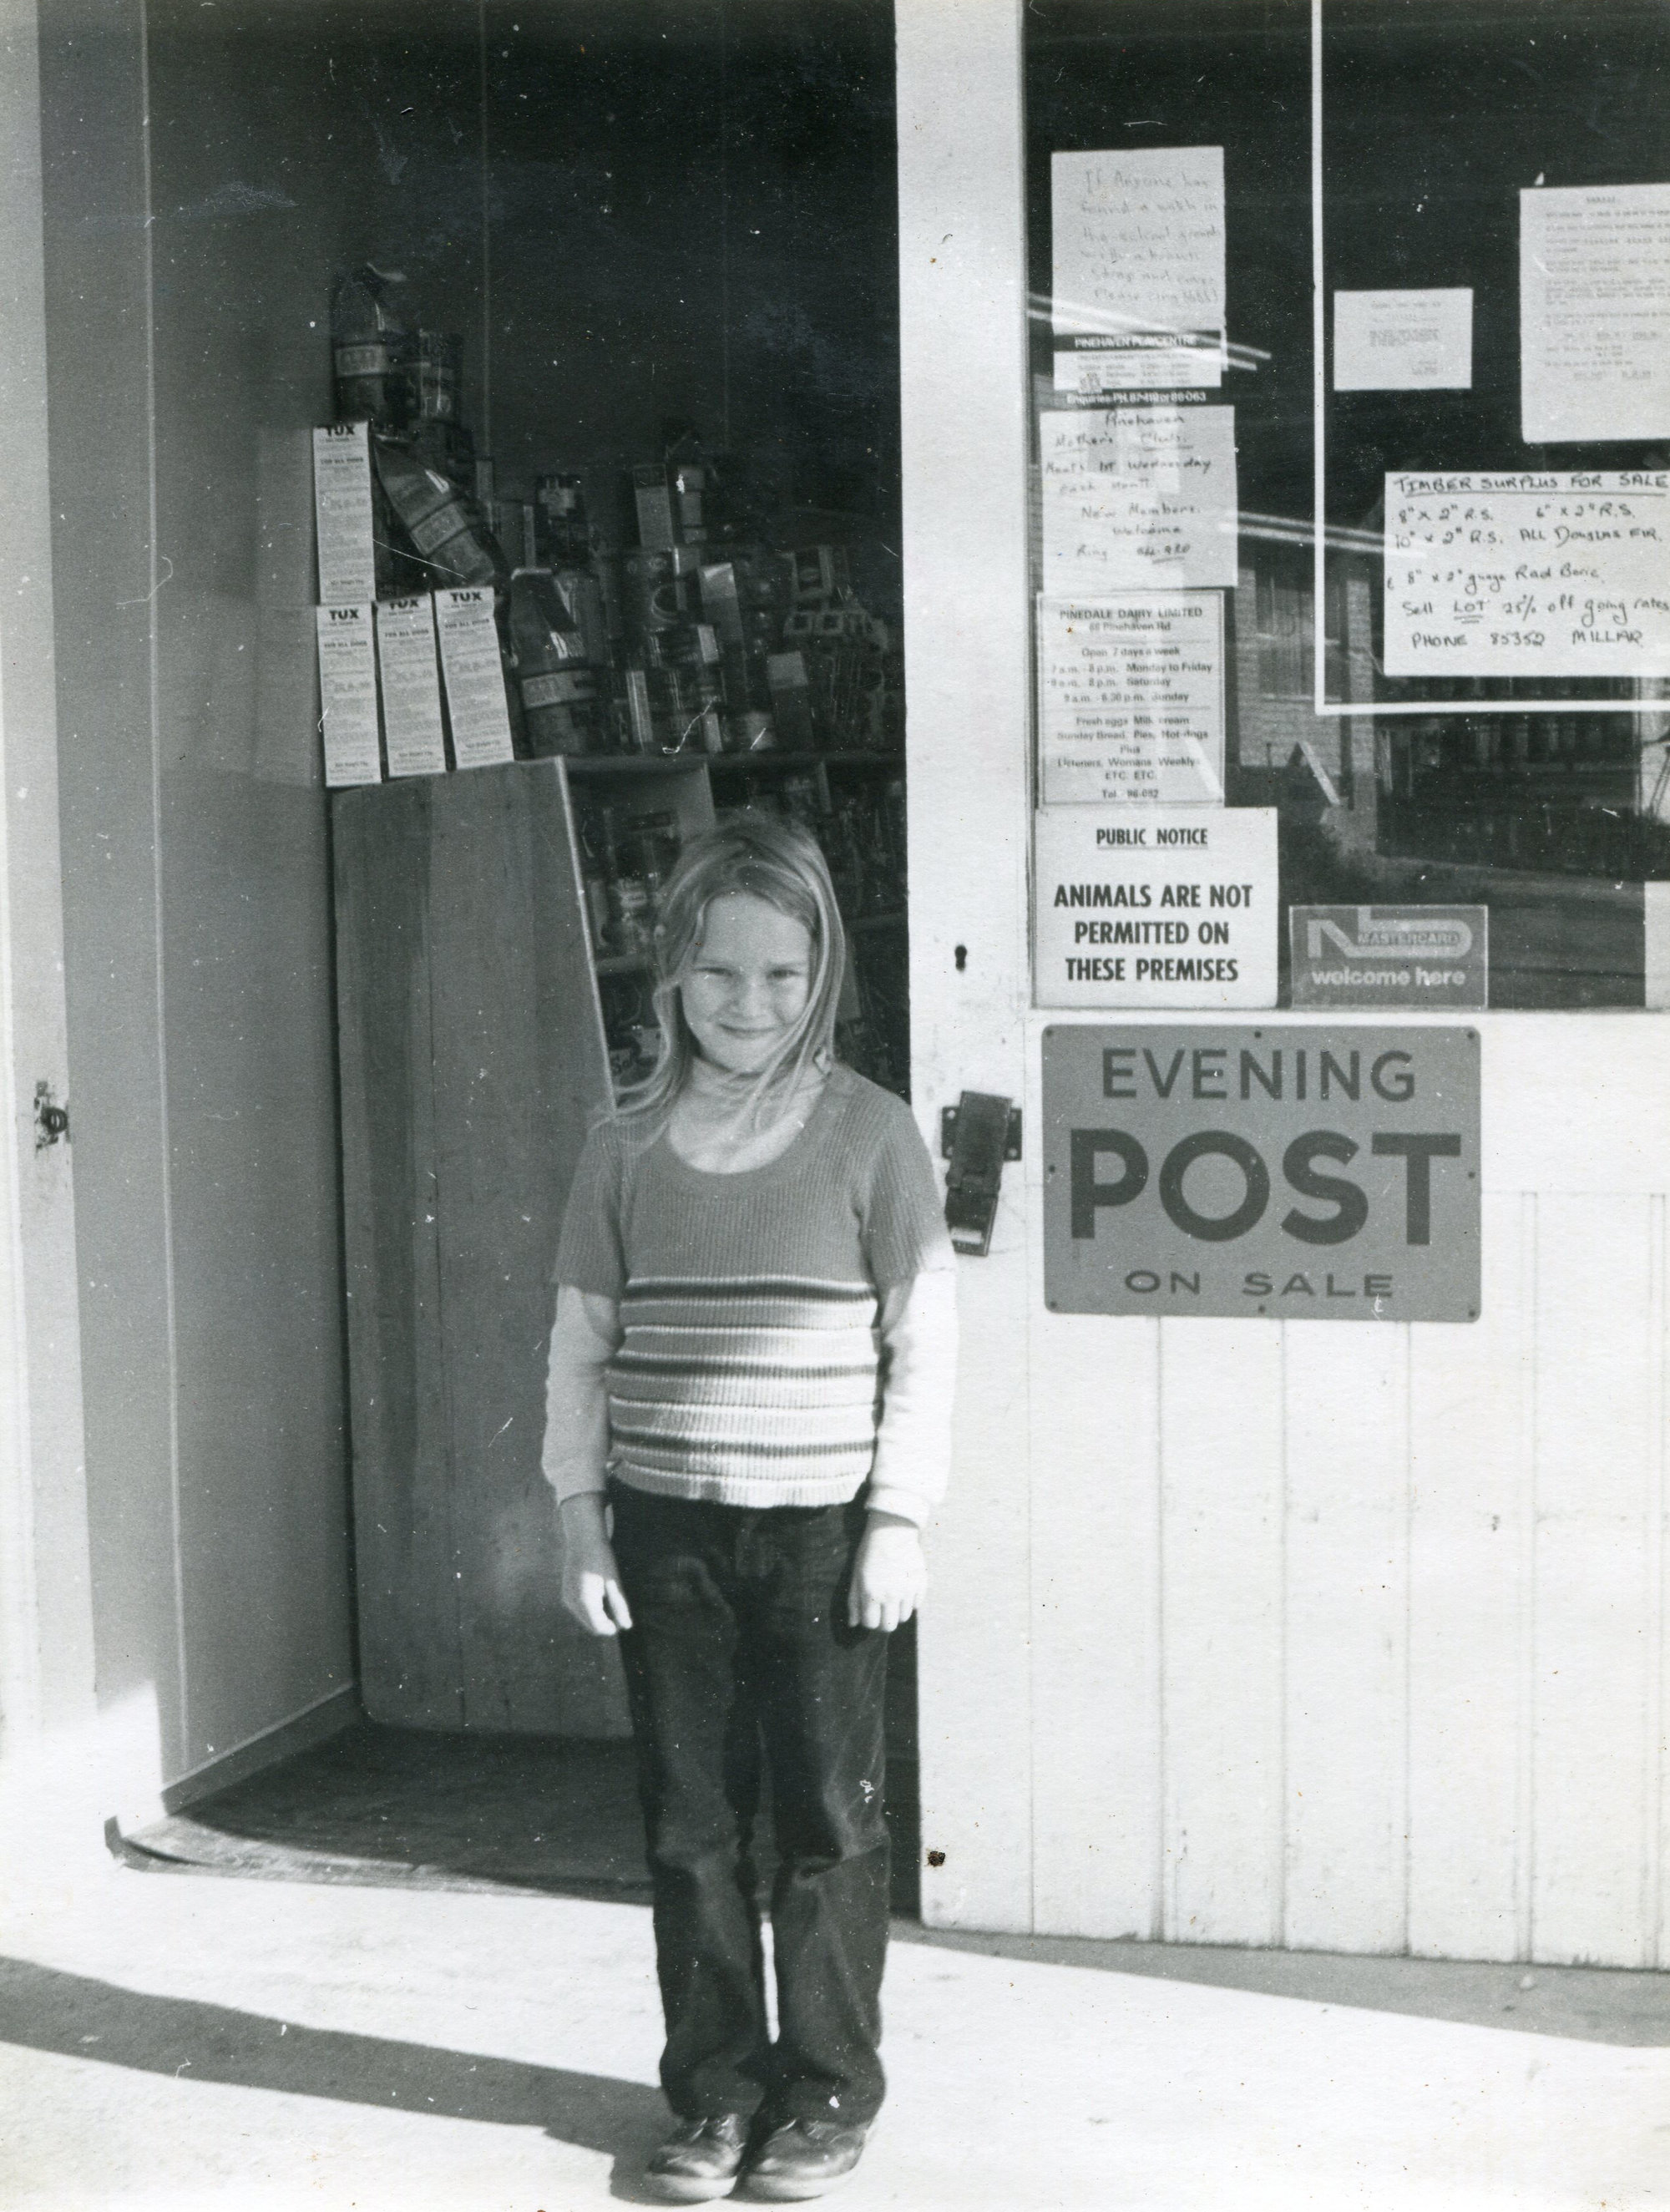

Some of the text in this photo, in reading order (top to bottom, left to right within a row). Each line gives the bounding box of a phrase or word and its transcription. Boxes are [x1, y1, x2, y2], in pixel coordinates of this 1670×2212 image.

[326, 425, 356, 437] TUX
[1394, 472, 1669, 493] TIMBER SURPLUS FOR SALE
[1519, 527, 1546, 541] ALL
[389, 598, 419, 610] TUX
[450, 590, 483, 603] TUX
[329, 608, 360, 621] TUX
[1060, 607, 1202, 620] PINEDALE DAIRY LIMITED
[1402, 600, 1433, 616] Sell
[1453, 600, 1485, 615] LOT
[1546, 594, 1576, 614] off
[1581, 600, 1627, 628] going
[1411, 632, 1468, 649] PHONE
[1490, 631, 1546, 647] 85352
[1081, 648, 1108, 658] Open
[1121, 647, 1144, 658] days
[1154, 646, 1180, 656] week
[1126, 663, 1167, 675] Monday
[1181, 662, 1212, 675] Friday
[1096, 828, 1208, 846] PUBLIC NOTICE
[1054, 883, 1252, 909] ANIMALS ARE NOT
[1074, 921, 1230, 944] PERMITTED ON
[1065, 958, 1239, 982] THESE PREMISES
[1312, 965, 1466, 986] welcome here
[1102, 1047, 1416, 1102] EVENING
[1070, 1127, 1461, 1246] POST
[1124, 1269, 1394, 1298] ON SALE
